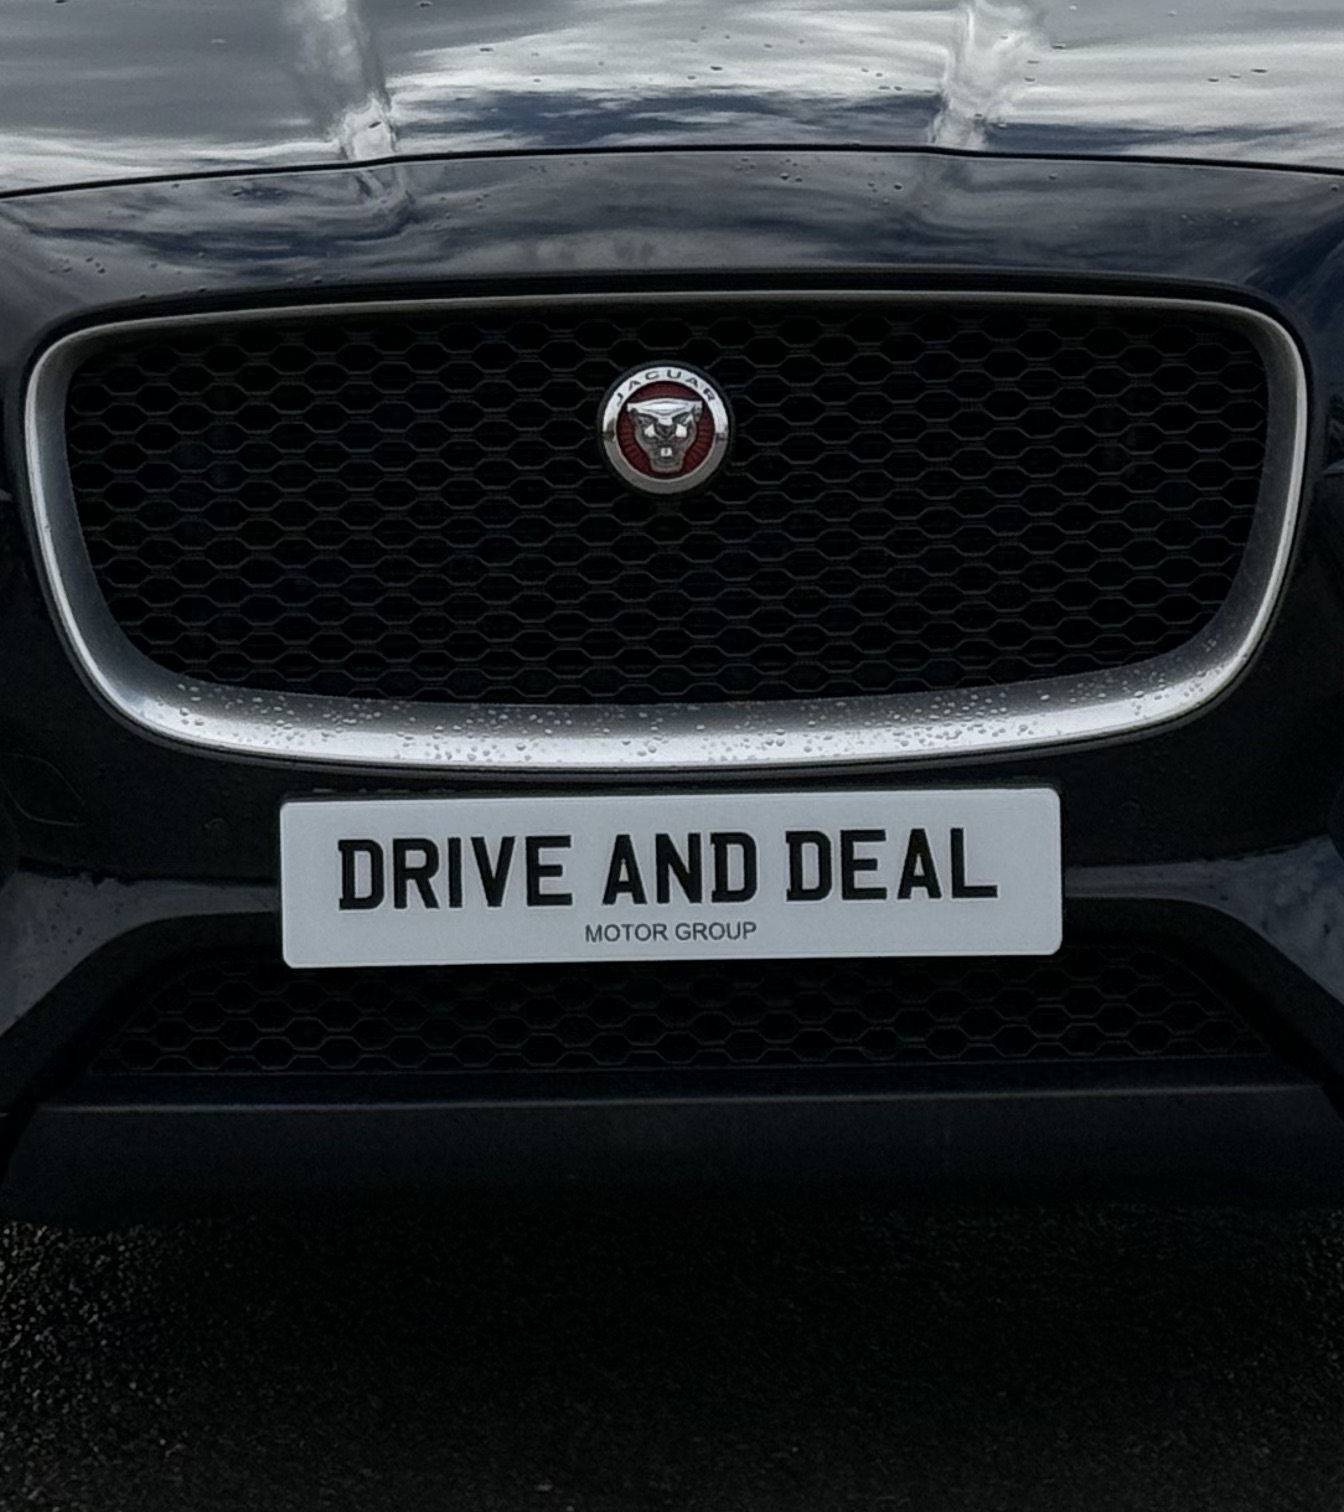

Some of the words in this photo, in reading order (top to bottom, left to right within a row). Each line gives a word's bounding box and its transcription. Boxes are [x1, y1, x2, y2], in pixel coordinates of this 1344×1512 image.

[616, 369, 716, 408] JAGUAR
[337, 835, 573, 910] DRIVE
[602, 832, 757, 905] AND
[785, 828, 998, 902] DEAL
[585, 923, 668, 943] MOTOR
[674, 921, 757, 941] GROUP
